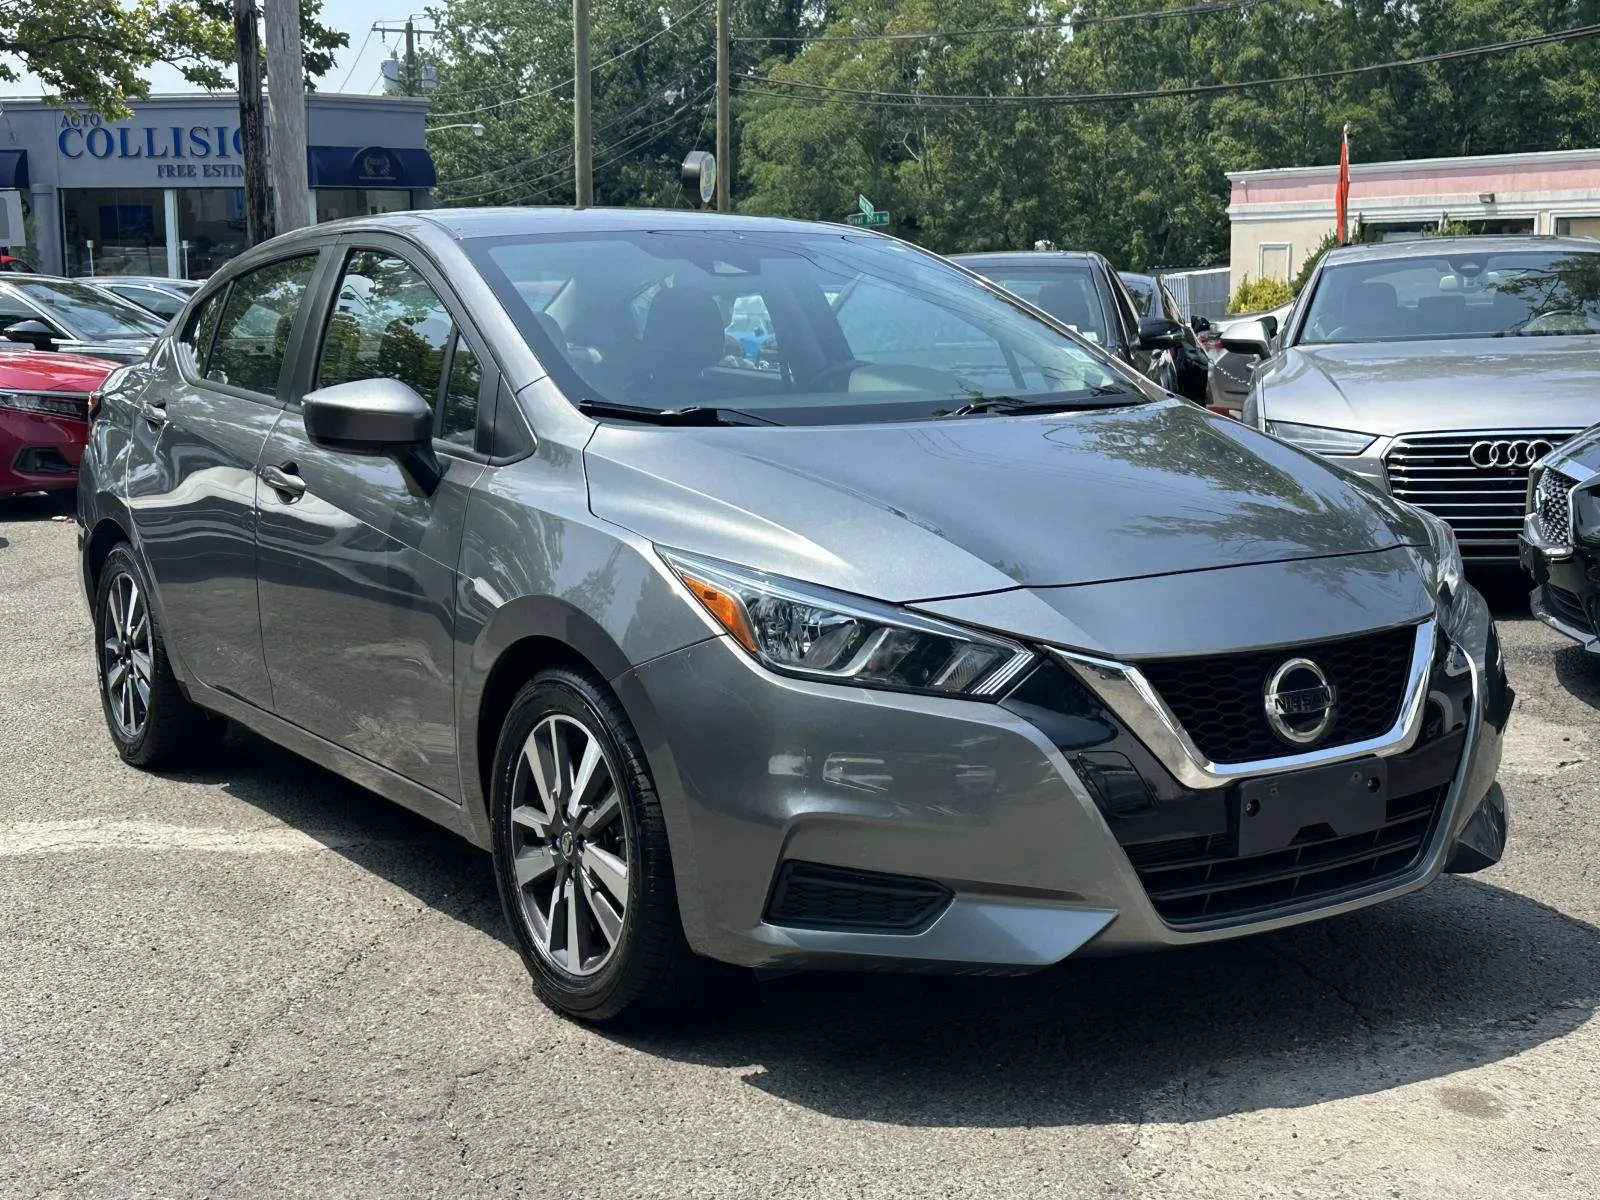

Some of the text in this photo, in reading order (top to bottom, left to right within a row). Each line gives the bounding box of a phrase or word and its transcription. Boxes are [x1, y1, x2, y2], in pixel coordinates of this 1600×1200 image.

[61, 112, 101, 127] AUTO
[58, 126, 270, 159] COLLISI
[157, 164, 197, 178] FREE
[1275, 690, 1331, 711] NISSN
